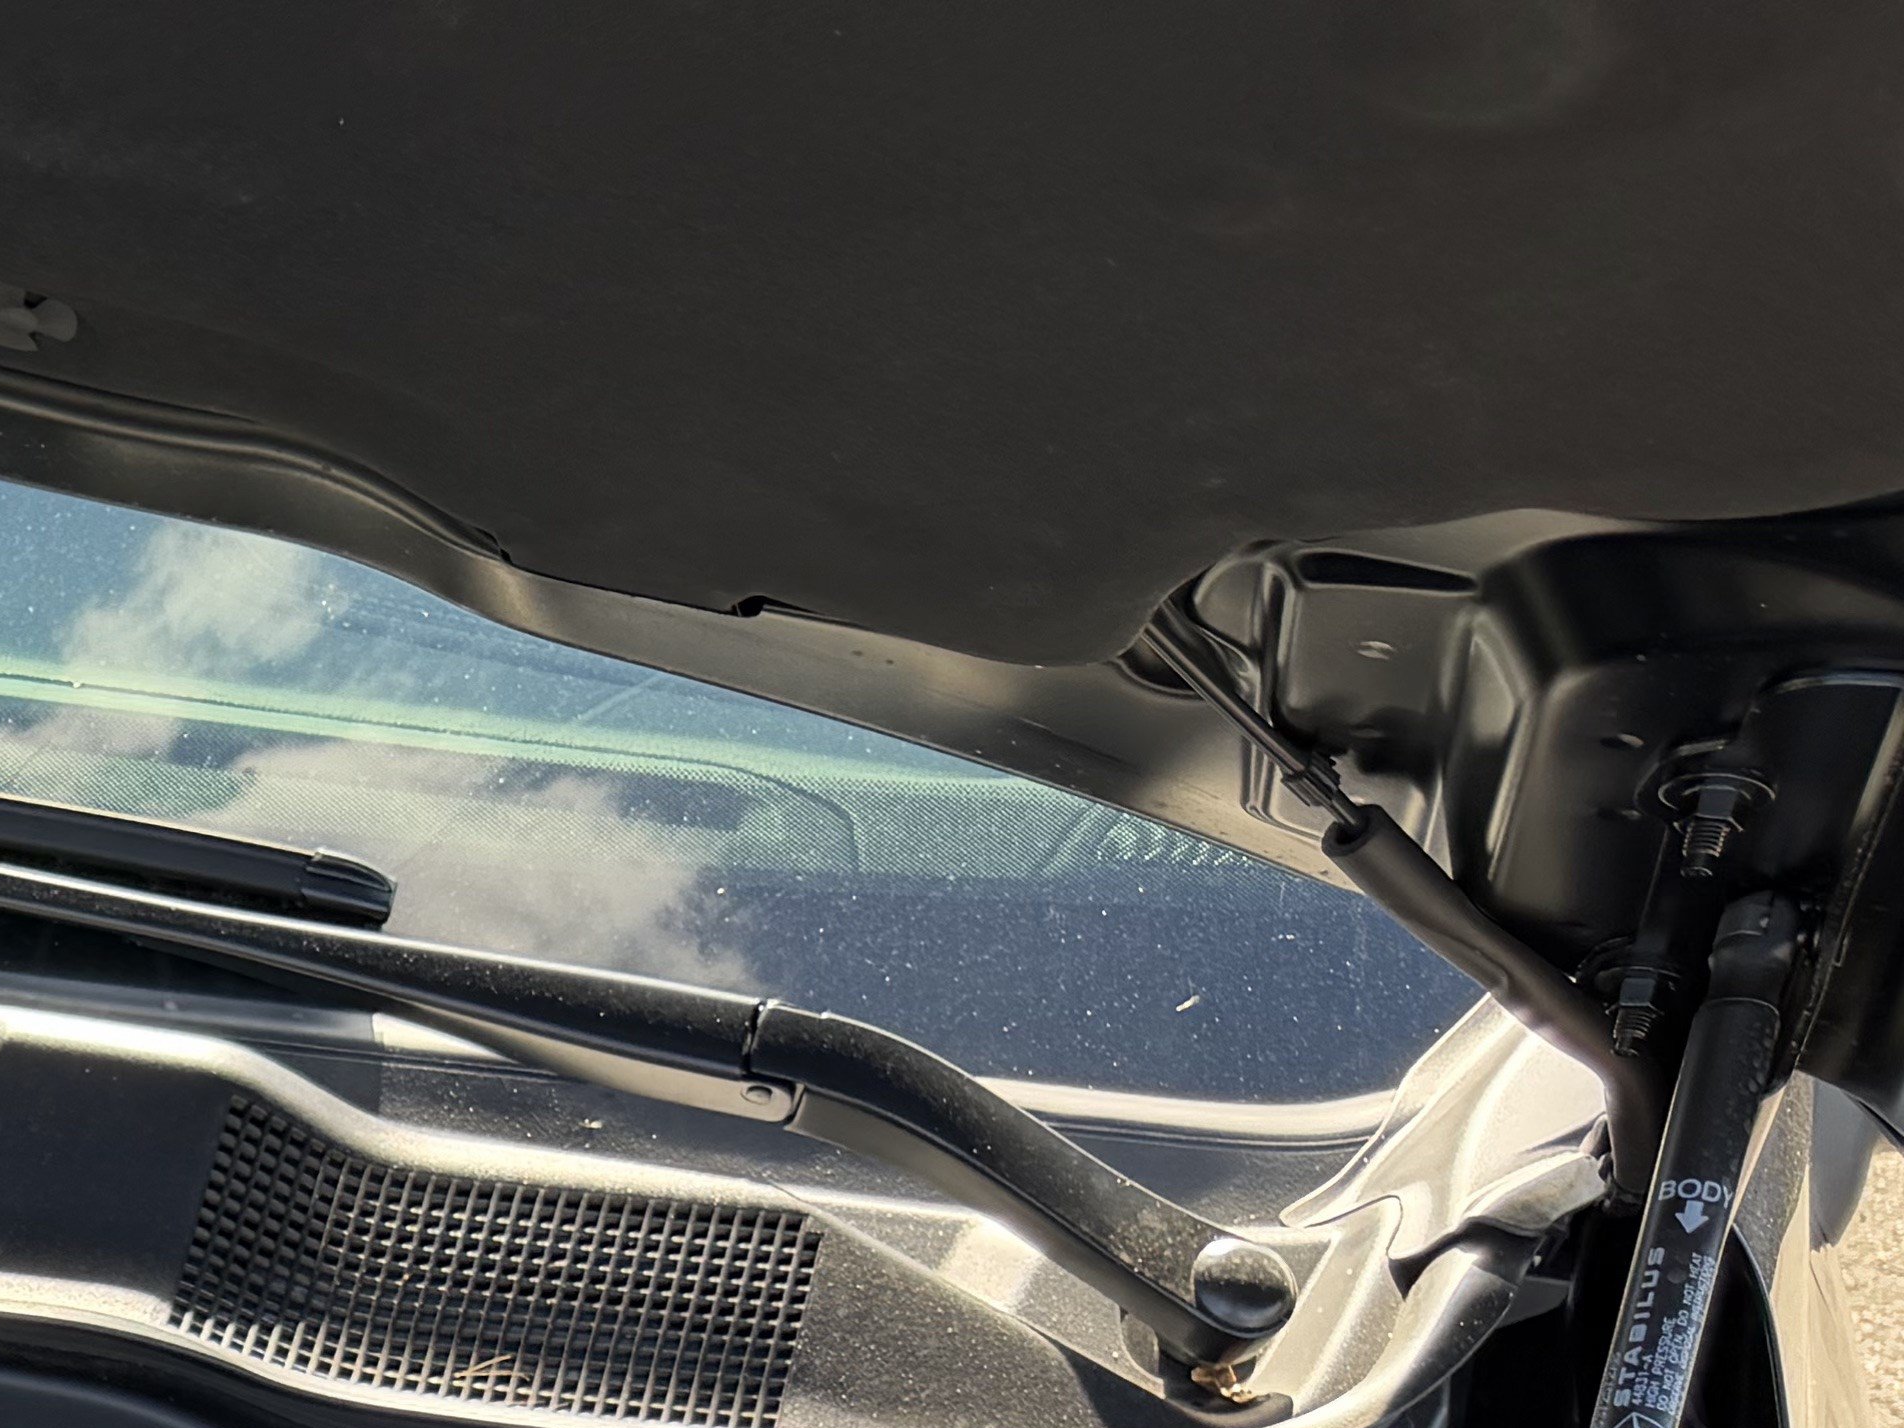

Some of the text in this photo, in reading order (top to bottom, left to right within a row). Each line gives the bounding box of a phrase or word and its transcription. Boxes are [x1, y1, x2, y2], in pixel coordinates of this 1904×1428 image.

[1658, 1177, 1733, 1208] BODY
[1687, 1252, 1701, 1278] HEAT
[1682, 1284, 1694, 1304] NOT
[1613, 1246, 1665, 1408] STABILUS
[1677, 1310, 1688, 1325] DO
[1645, 1316, 1676, 1407] HIGH PRESSURE
[1662, 1369, 1674, 1389] NOT
[1657, 1395, 1667, 1410] DO
